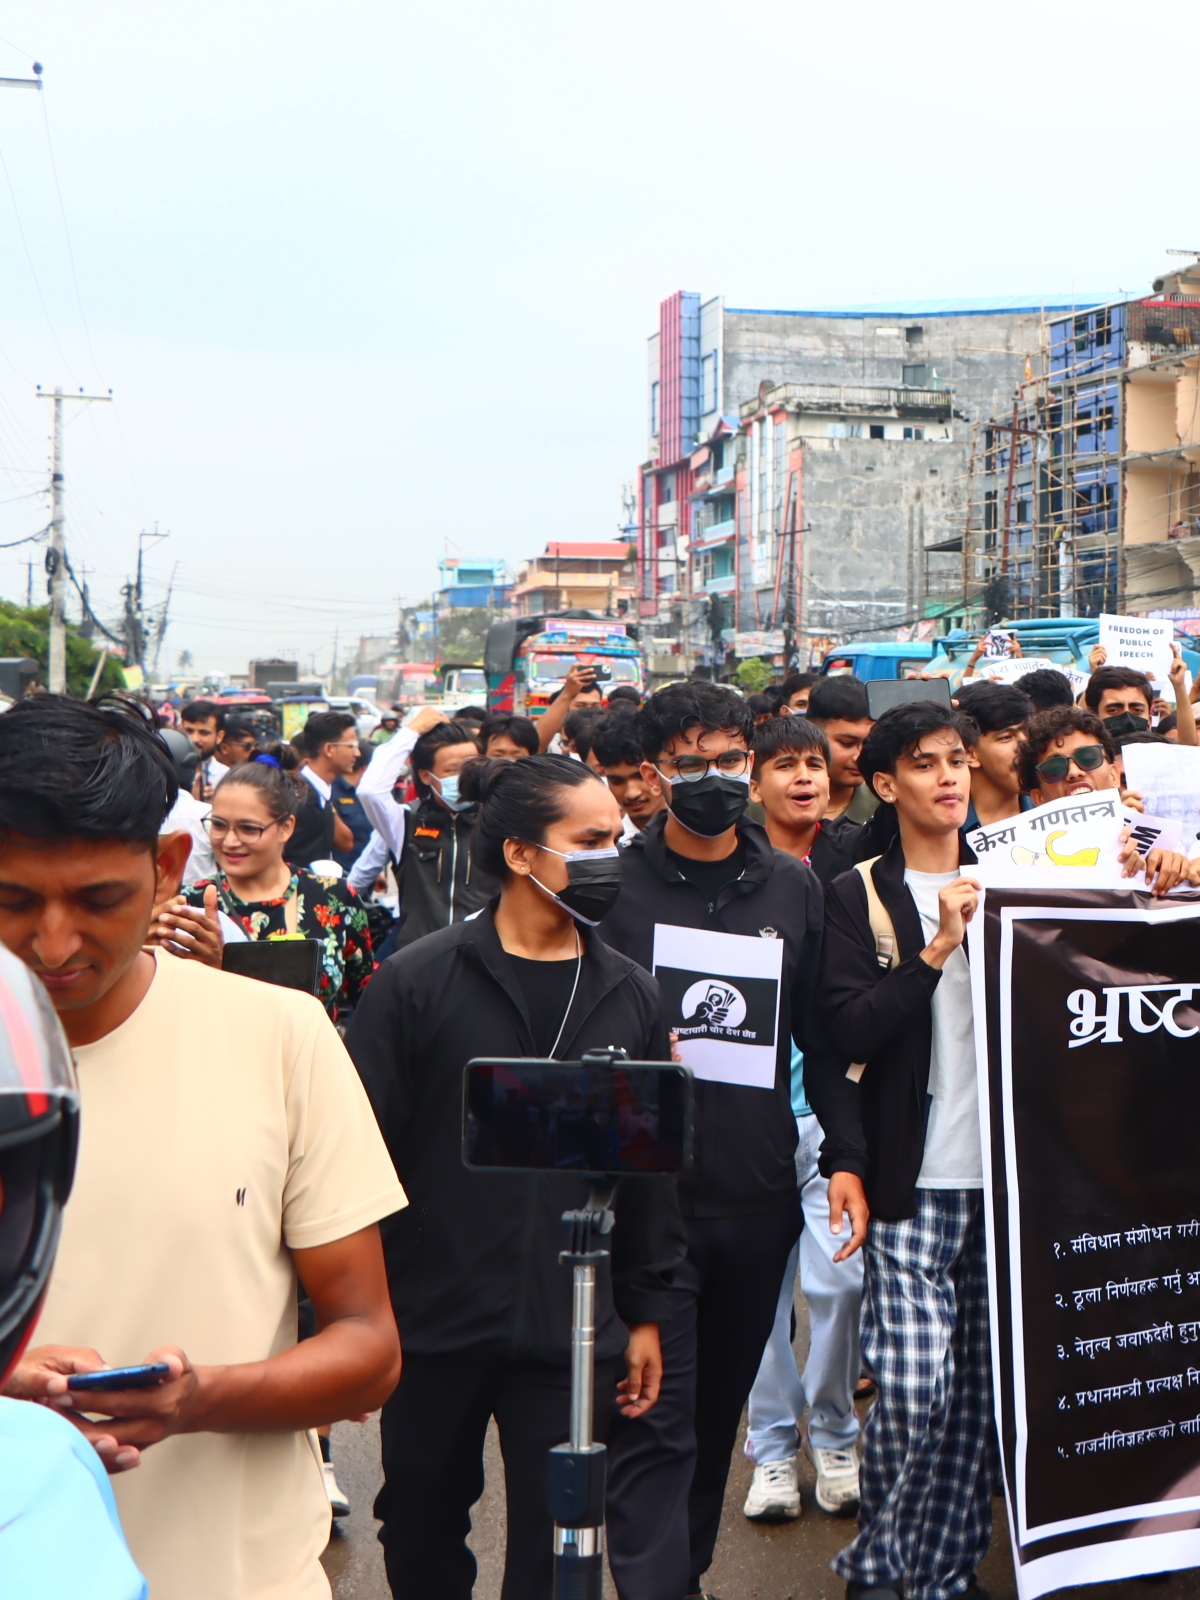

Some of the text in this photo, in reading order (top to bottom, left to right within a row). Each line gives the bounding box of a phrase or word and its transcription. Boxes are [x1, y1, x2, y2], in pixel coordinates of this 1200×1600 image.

[1108, 625, 1165, 635] FREEDOM OF
[1119, 639, 1152, 647] PUBLIC
[1119, 651, 1154, 659] SPEECH
[987, 665, 1009, 677] केरा
[1066, 670, 1083, 684] केरा
[974, 800, 1116, 854] केरा गणतन्त्र
[672, 1024, 708, 1035] भ्रष्टाचारी
[709, 1026, 724, 1034] चोर
[726, 1027, 740, 1037] देश
[1070, 1232, 1121, 1254] संविधान
[1125, 1224, 1172, 1246] संशोधन
[1177, 1219, 1200, 1238] गरी
[1073, 1287, 1102, 1311] ठूला
[1105, 1277, 1158, 1301] निर्णयहरू
[1162, 1270, 1183, 1294] गर्नु
[1075, 1336, 1111, 1359] नेतृत्व
[1116, 1321, 1174, 1349] जवाफदेही
[1076, 1378, 1142, 1406] प्रधानमन्त्री
[1146, 1374, 1183, 1396] प्रत्यक्ष
[1075, 1420, 1175, 1455] राजनीतिज्ञहरूको
